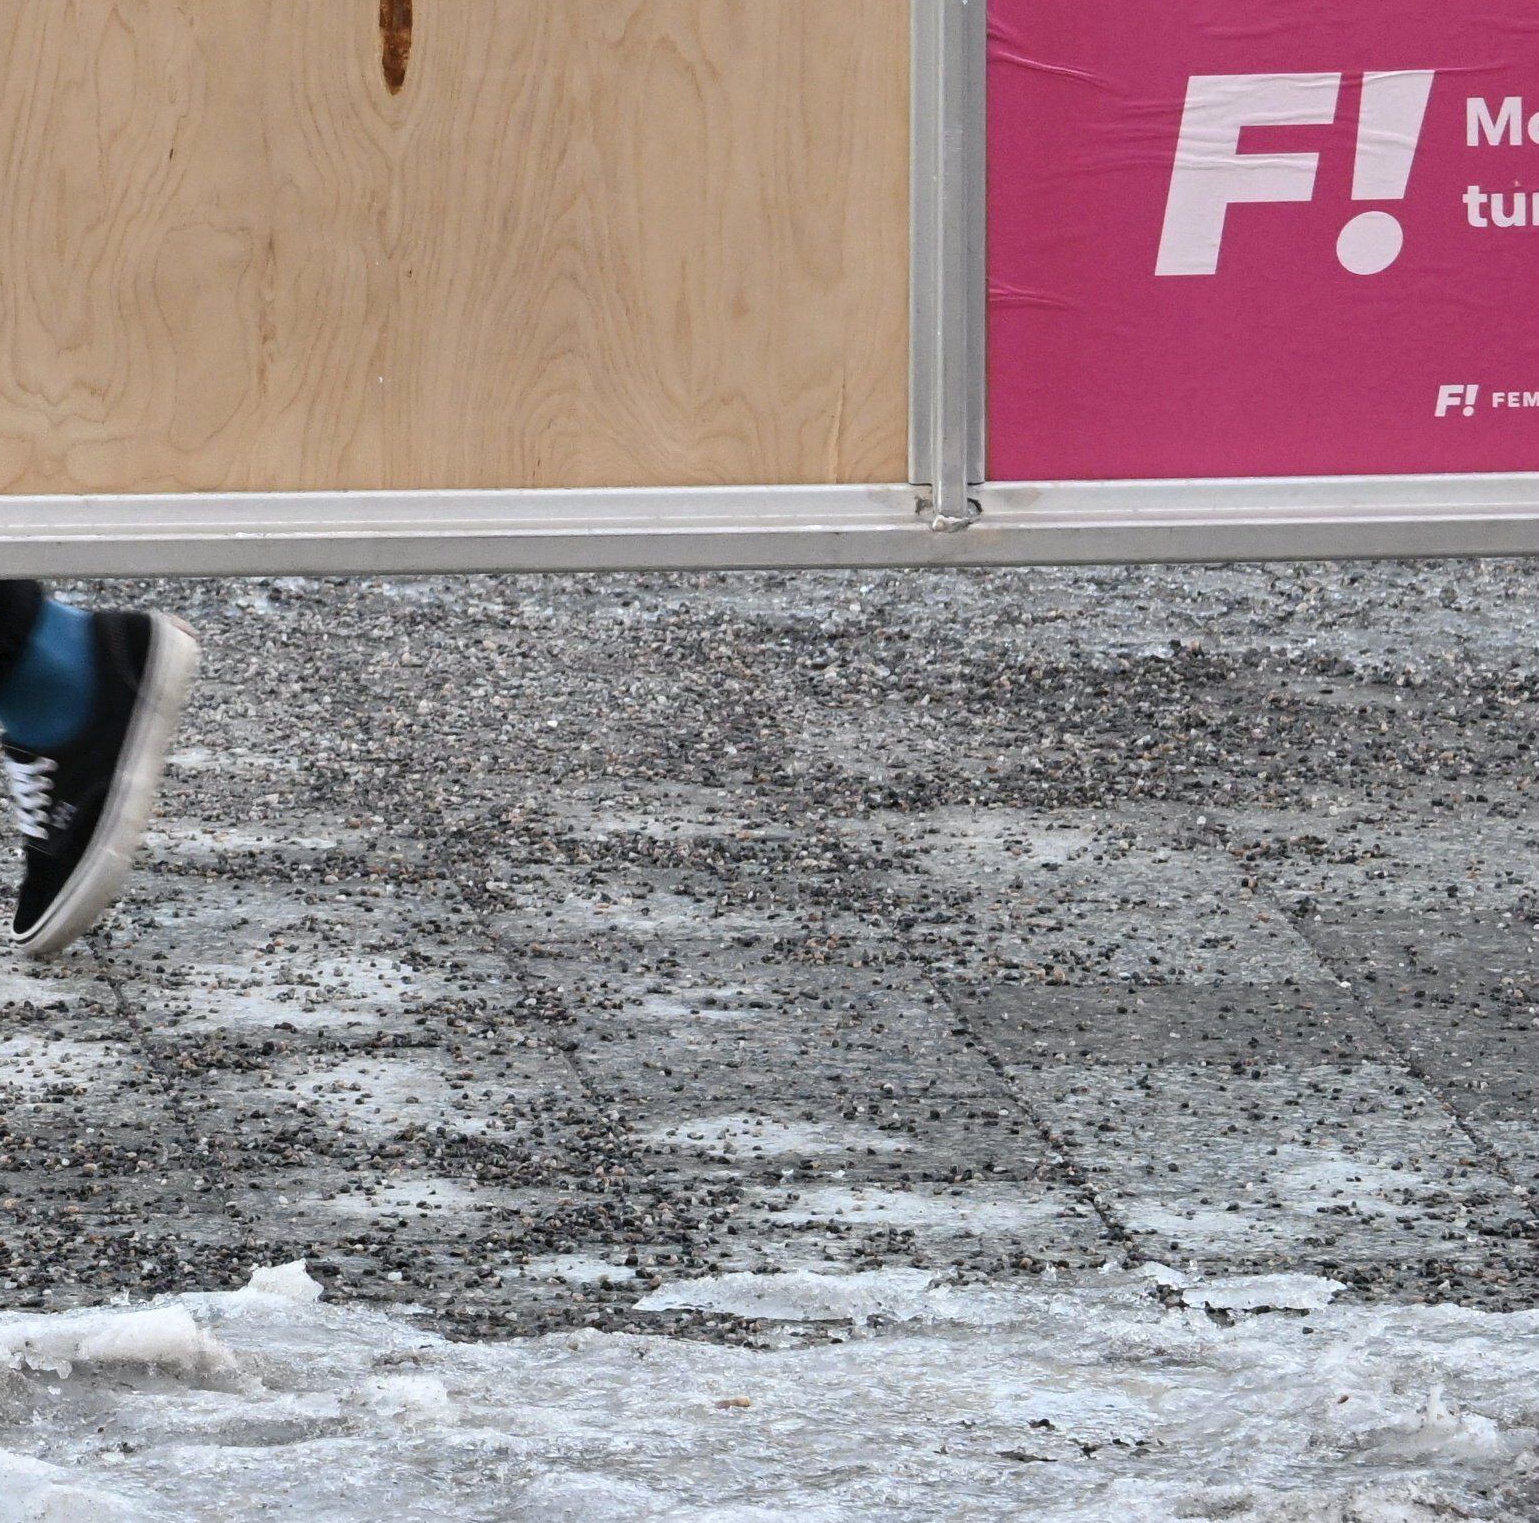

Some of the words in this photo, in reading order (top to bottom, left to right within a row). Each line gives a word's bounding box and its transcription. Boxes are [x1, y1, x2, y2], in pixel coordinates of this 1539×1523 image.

[1155, 70, 1435, 276] F!
[1462, 185, 1539, 228] tu
[1434, 384, 1479, 417] F!
